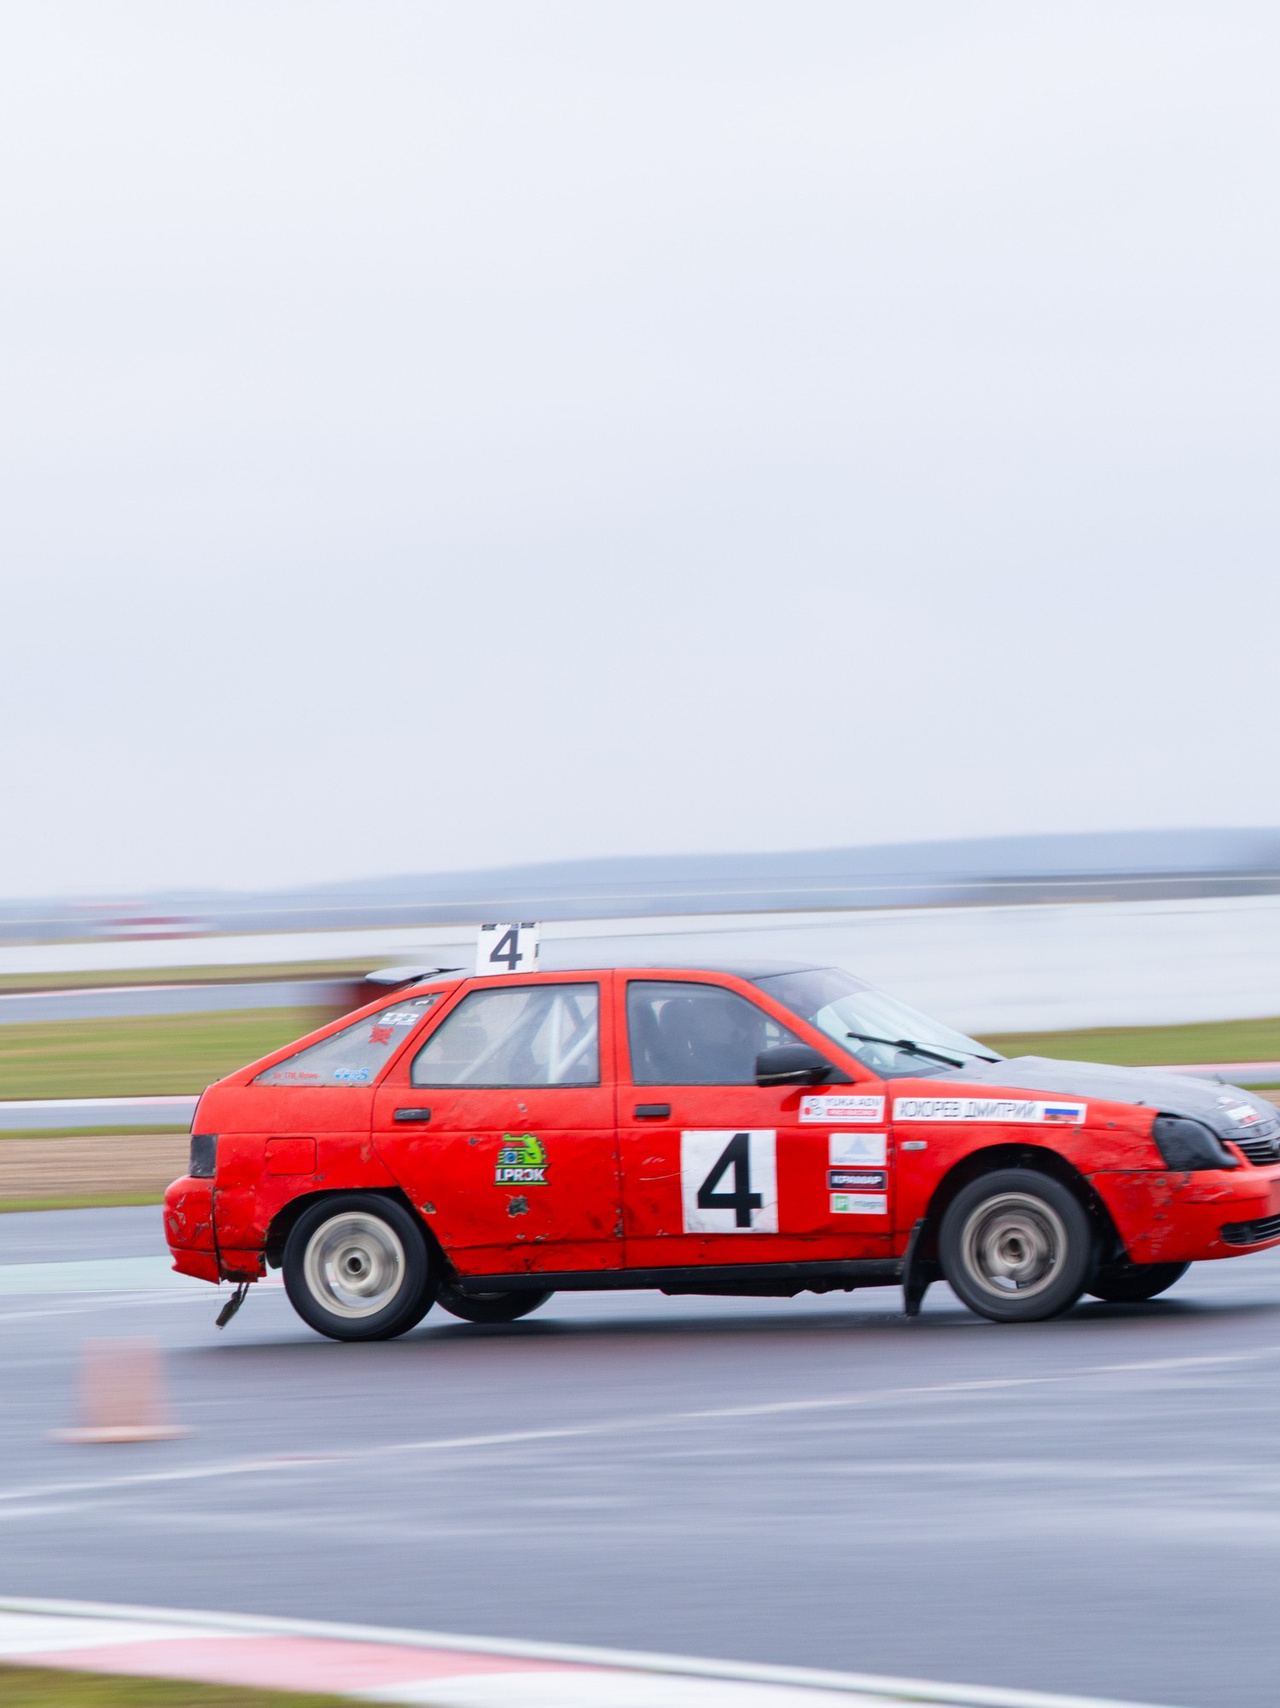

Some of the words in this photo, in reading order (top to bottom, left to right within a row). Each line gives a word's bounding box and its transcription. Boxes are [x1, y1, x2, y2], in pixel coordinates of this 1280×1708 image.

[490, 926, 523, 970] 4
[900, 1101, 959, 1118] КОКОРЕВ
[964, 1100, 1038, 1119] ДМИТРИЙ
[697, 1132, 763, 1228] 4
